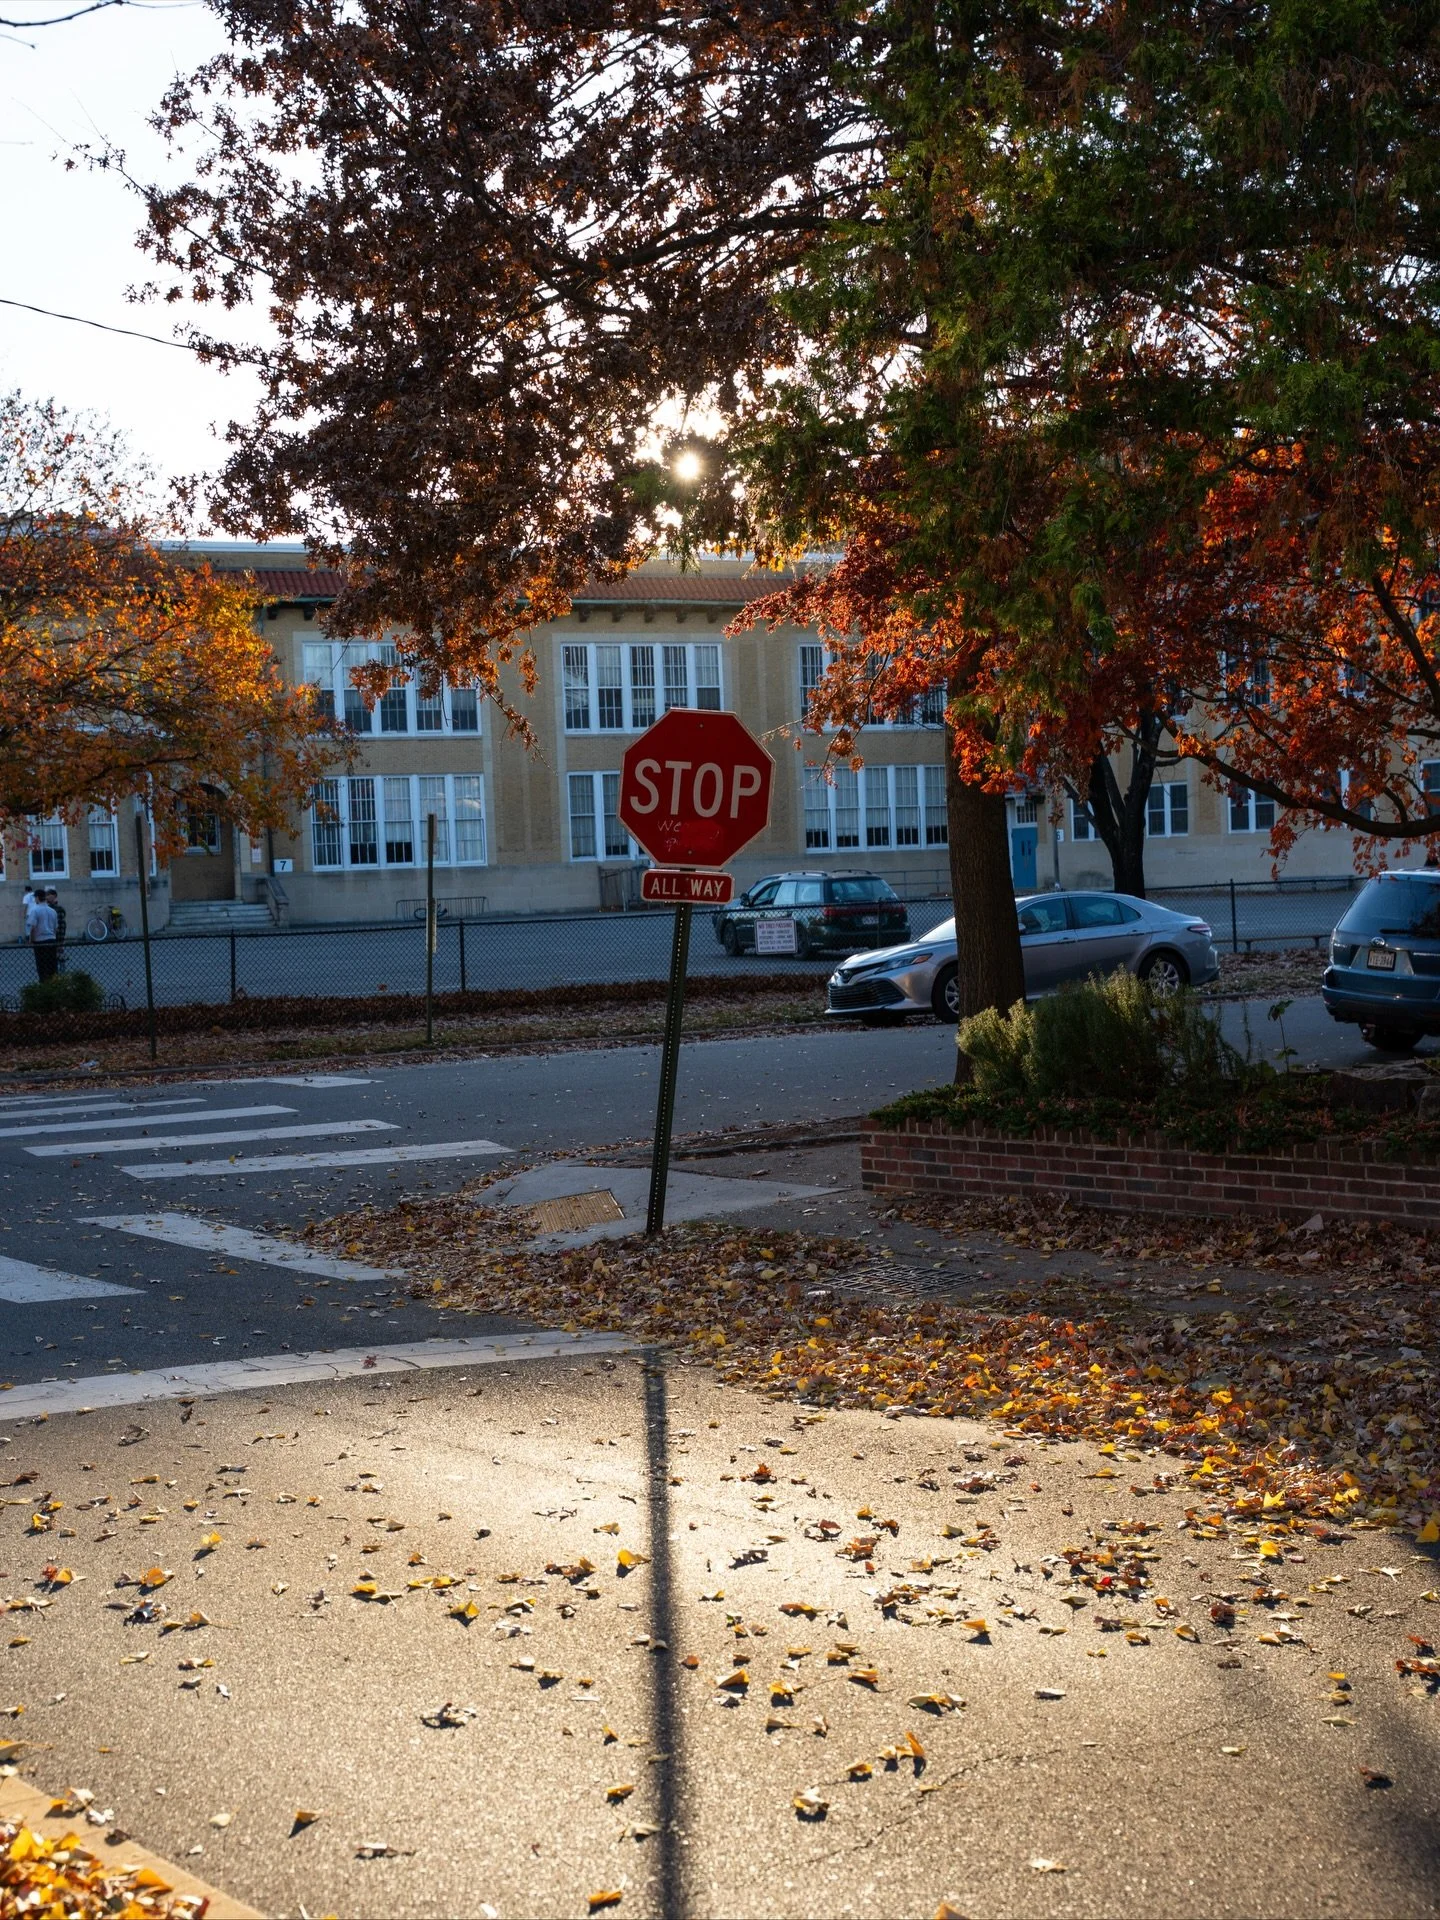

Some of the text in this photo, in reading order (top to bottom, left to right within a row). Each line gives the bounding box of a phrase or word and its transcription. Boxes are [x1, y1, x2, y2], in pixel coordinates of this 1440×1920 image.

[630, 758, 762, 819] STOP
[280, 861, 287, 870] 7
[650, 877, 725, 898] ALL WAY
